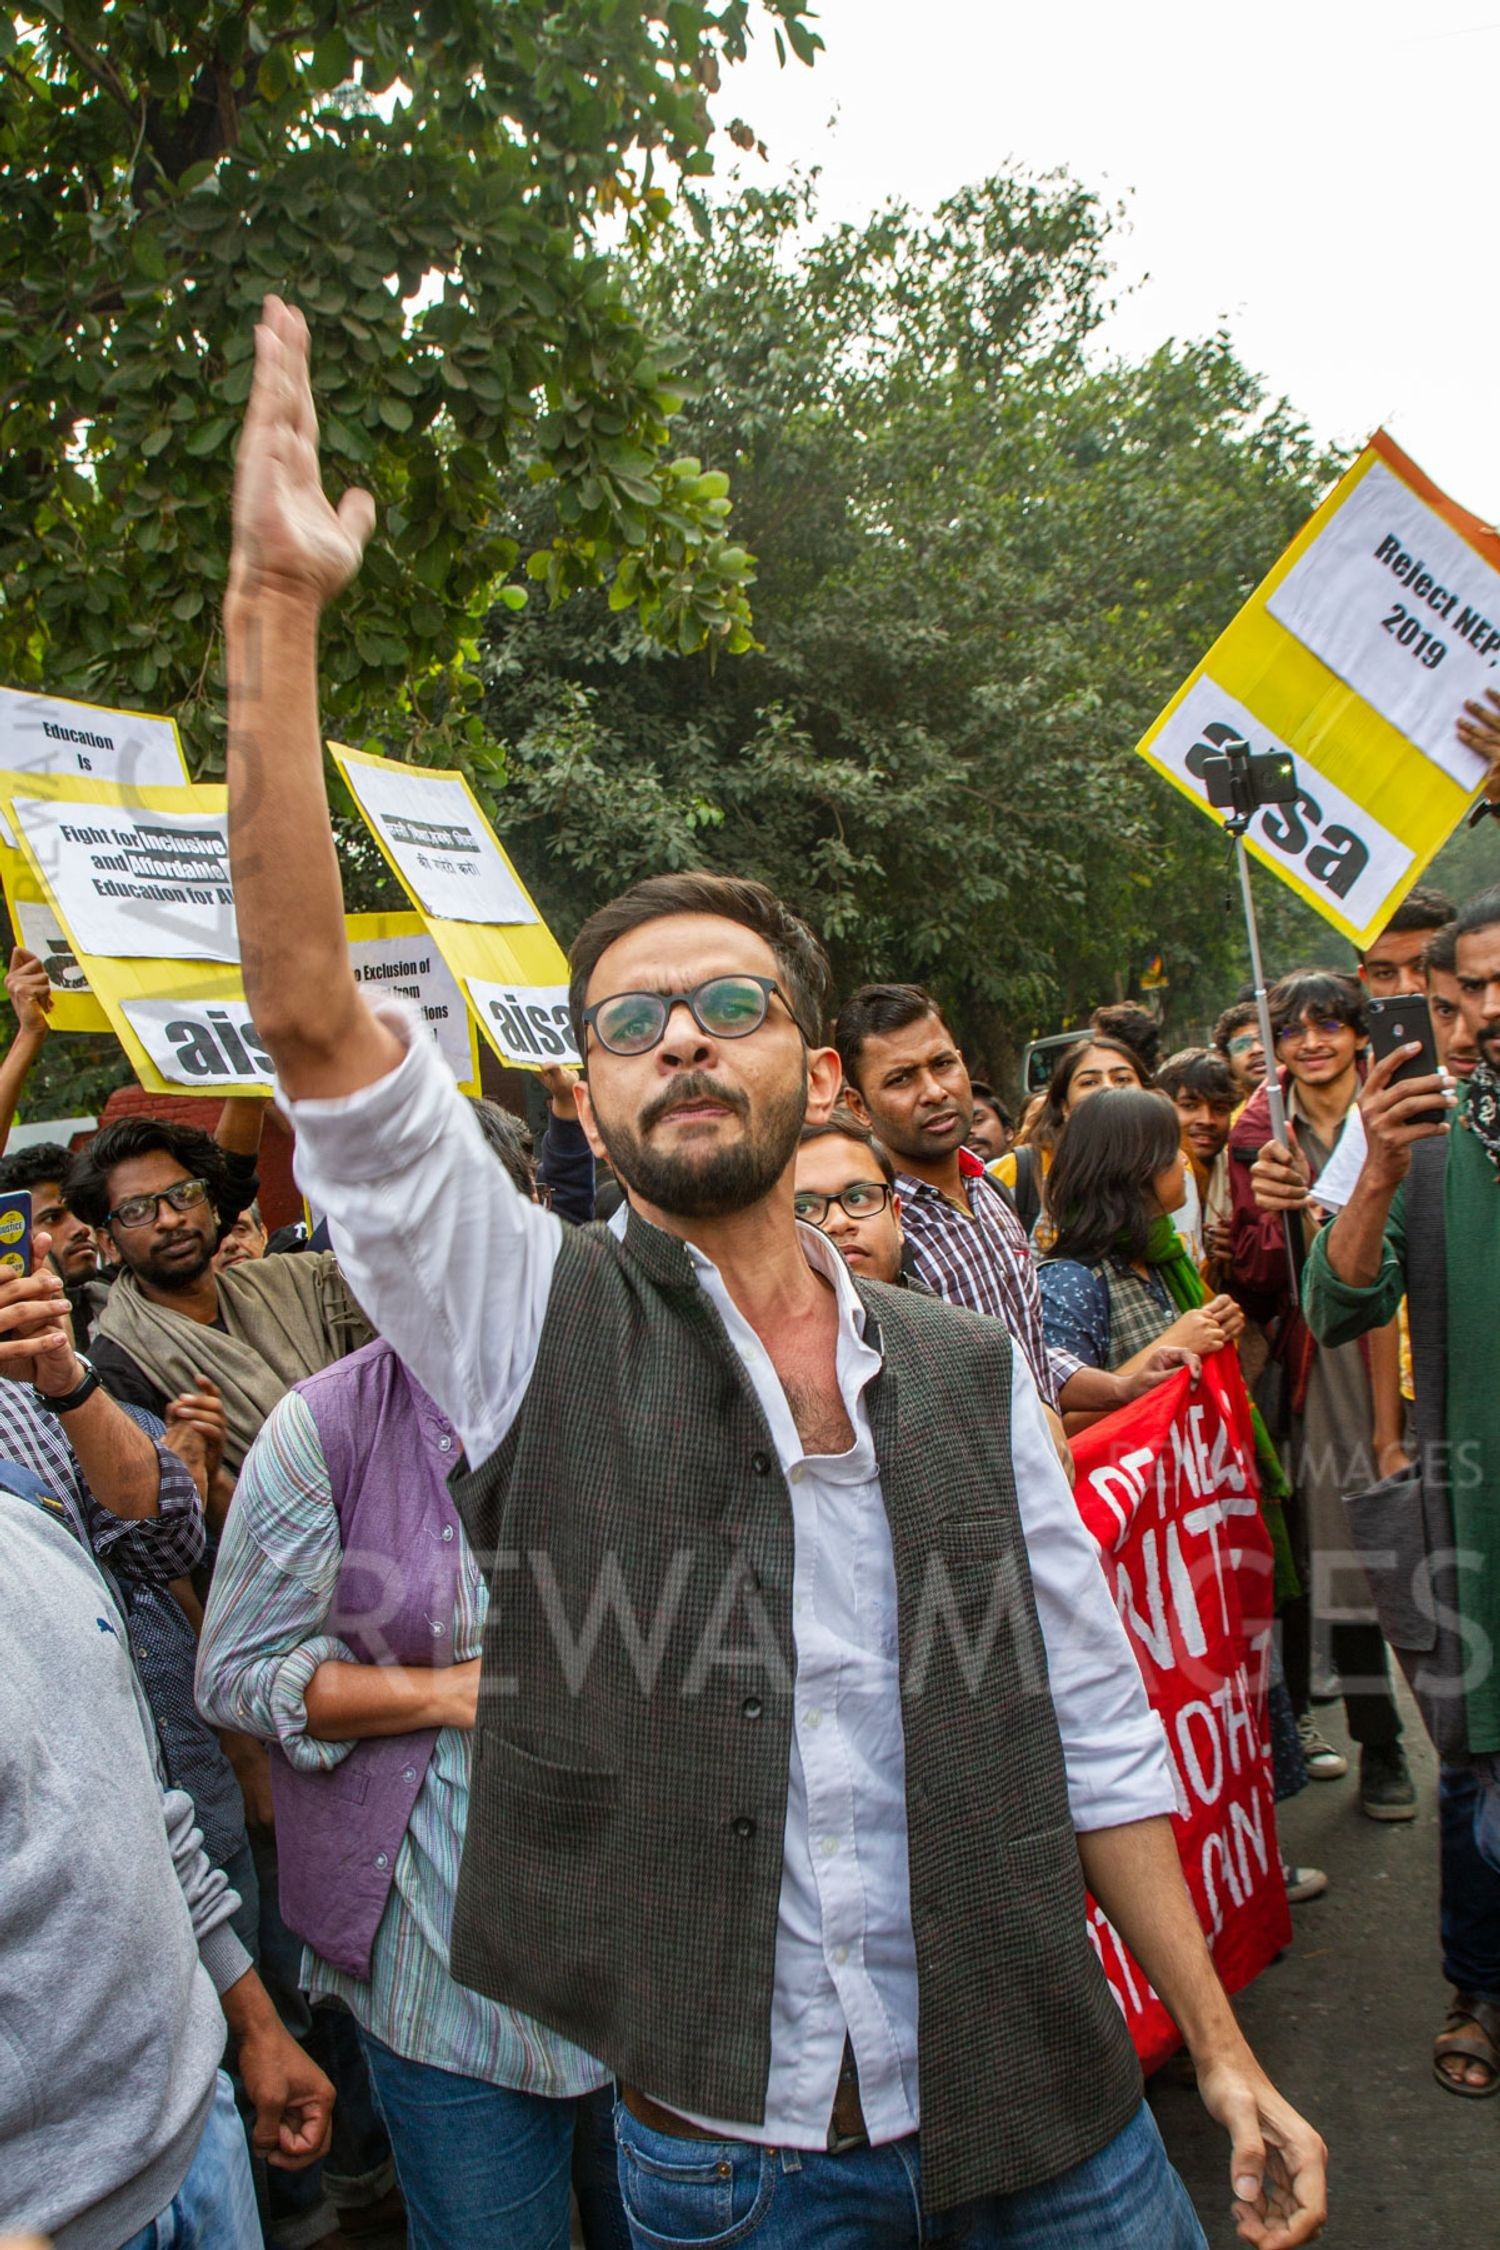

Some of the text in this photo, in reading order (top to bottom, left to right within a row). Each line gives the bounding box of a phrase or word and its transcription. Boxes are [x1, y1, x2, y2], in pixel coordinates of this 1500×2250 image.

[1373, 532, 1459, 622] Reject
[1381, 602, 1448, 670] 2019
[42, 720, 115, 751] Education
[77, 753, 93, 772] Is
[1184, 722, 1371, 900] asa
[59, 824, 227, 856] Fight for Inclusive
[90, 854, 226, 880] and Affordable
[91, 878, 187, 904] Education
[186, 887, 214, 905] for
[363, 960, 418, 982] Exclusion
[419, 957, 431, 975] of
